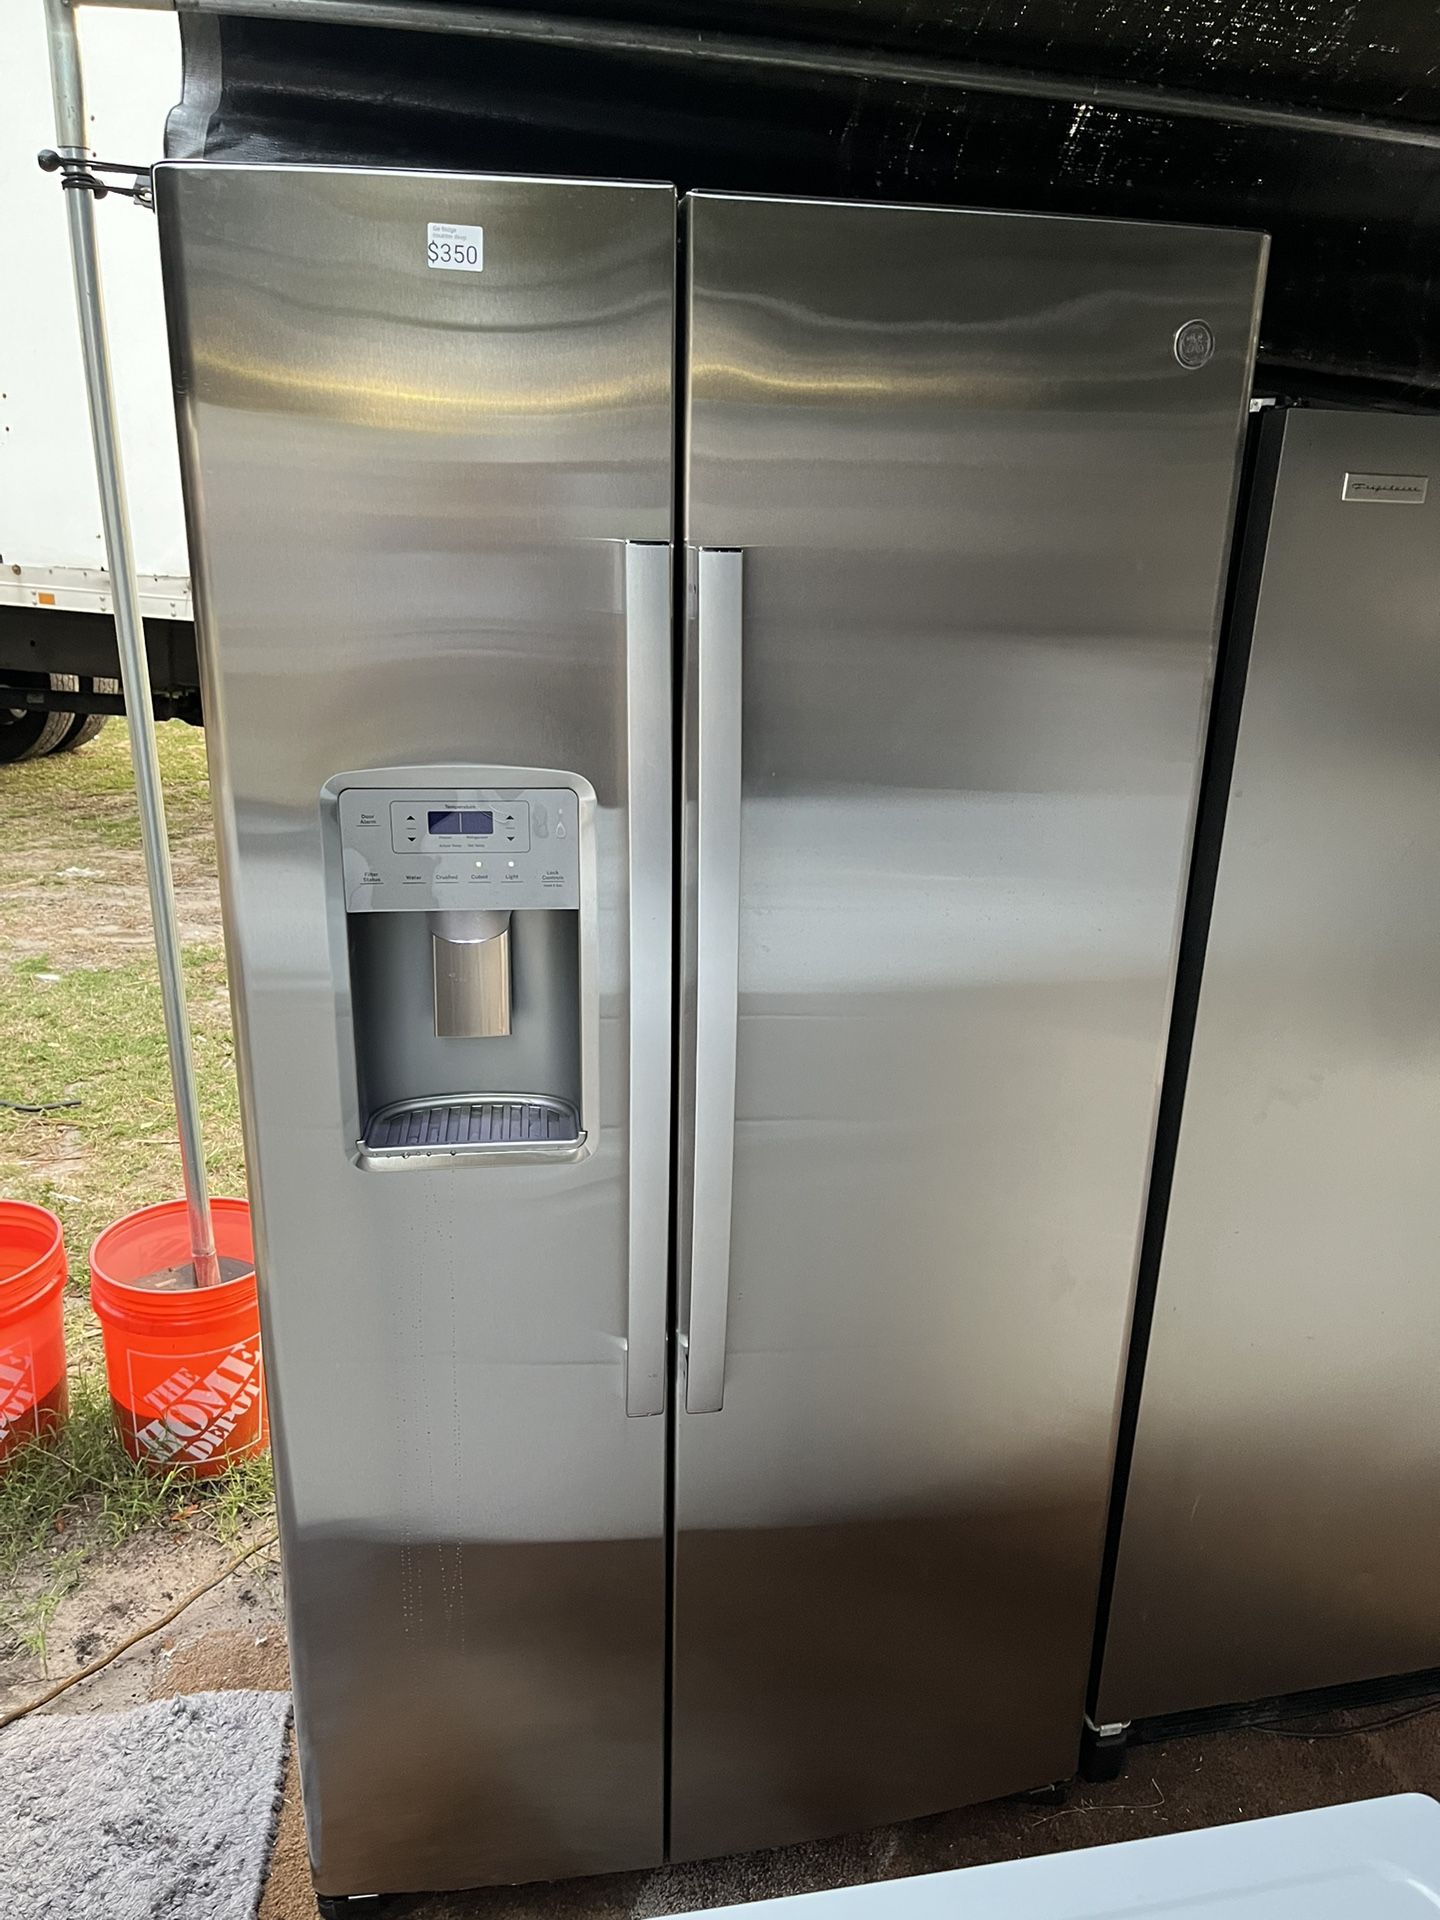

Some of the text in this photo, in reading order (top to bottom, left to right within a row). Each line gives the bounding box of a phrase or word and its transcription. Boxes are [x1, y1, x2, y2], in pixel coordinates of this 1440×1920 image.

[428, 240, 477, 264] $350
[504, 873, 520, 881] Light
[136, 1343, 260, 1461] HOME
[143, 1366, 201, 1414] THE
[184, 1377, 261, 1461] DEPOT
